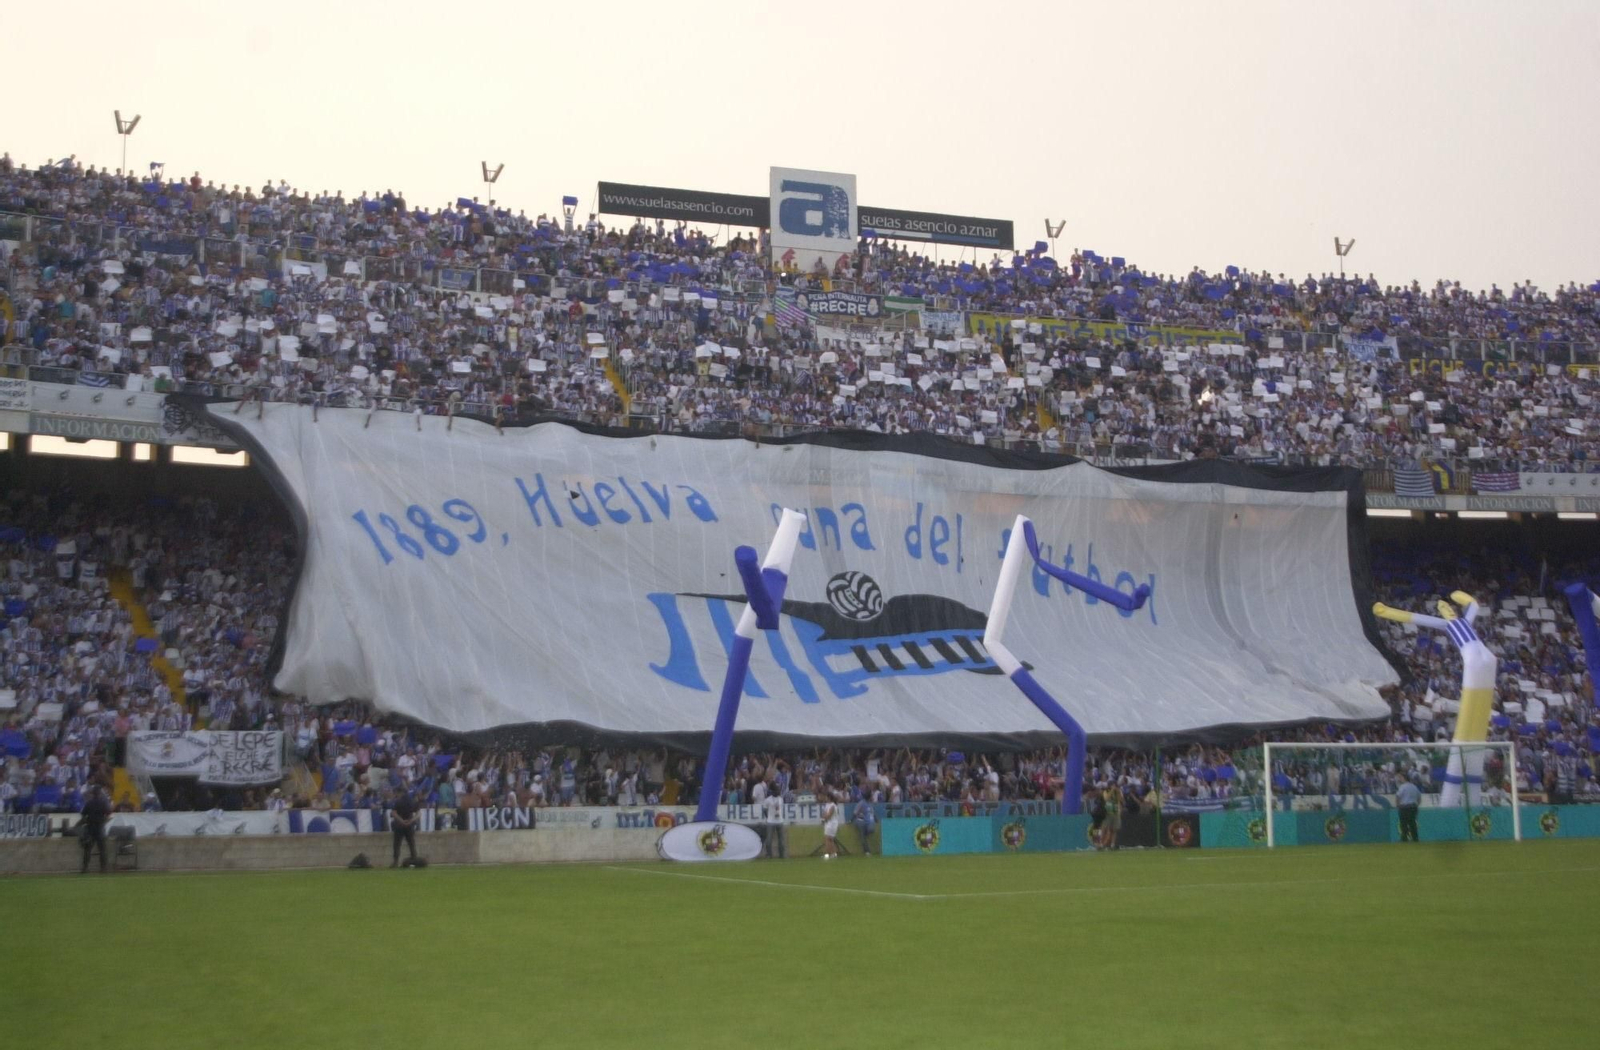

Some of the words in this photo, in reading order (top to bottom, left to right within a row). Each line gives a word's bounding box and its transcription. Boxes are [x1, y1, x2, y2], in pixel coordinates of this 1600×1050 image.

[603, 193, 754, 217] www.suelasasencio.com
[861, 214, 901, 229] suelas
[905, 218, 957, 234] asencio
[960, 224, 998, 238] aznar
[809, 299, 867, 316] #RECRE
[36, 418, 160, 441] INFORMACION
[1366, 494, 1444, 508] NFORMACION
[1469, 497, 1552, 510] INFORMACION
[515, 472, 719, 528] Huelva
[904, 502, 964, 573] del
[485, 807, 530, 830] BCN
